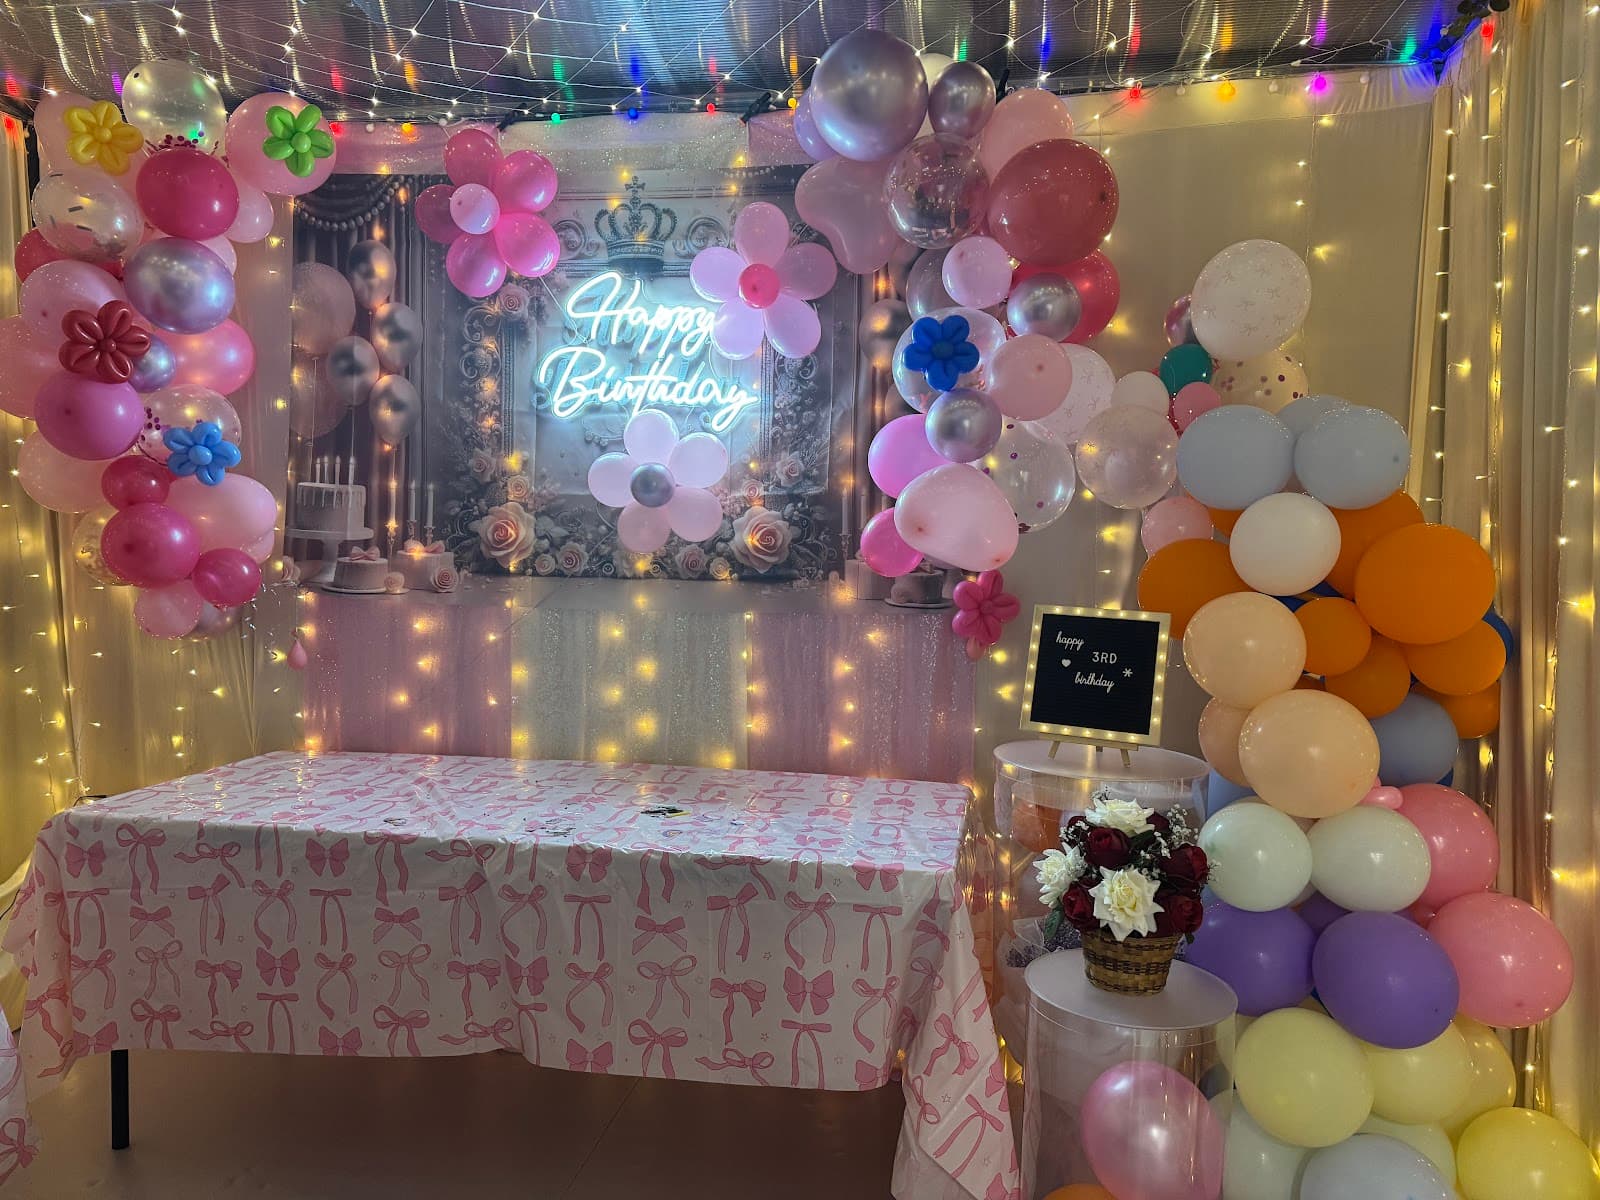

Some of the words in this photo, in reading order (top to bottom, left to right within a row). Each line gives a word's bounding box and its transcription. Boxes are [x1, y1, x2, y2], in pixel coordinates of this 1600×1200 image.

[565, 270, 722, 357] Happy
[538, 346, 760, 432] Birthday
[1055, 630, 1085, 651] happy
[1091, 651, 1118, 665] 3RD
[1074, 671, 1115, 694] birthday
